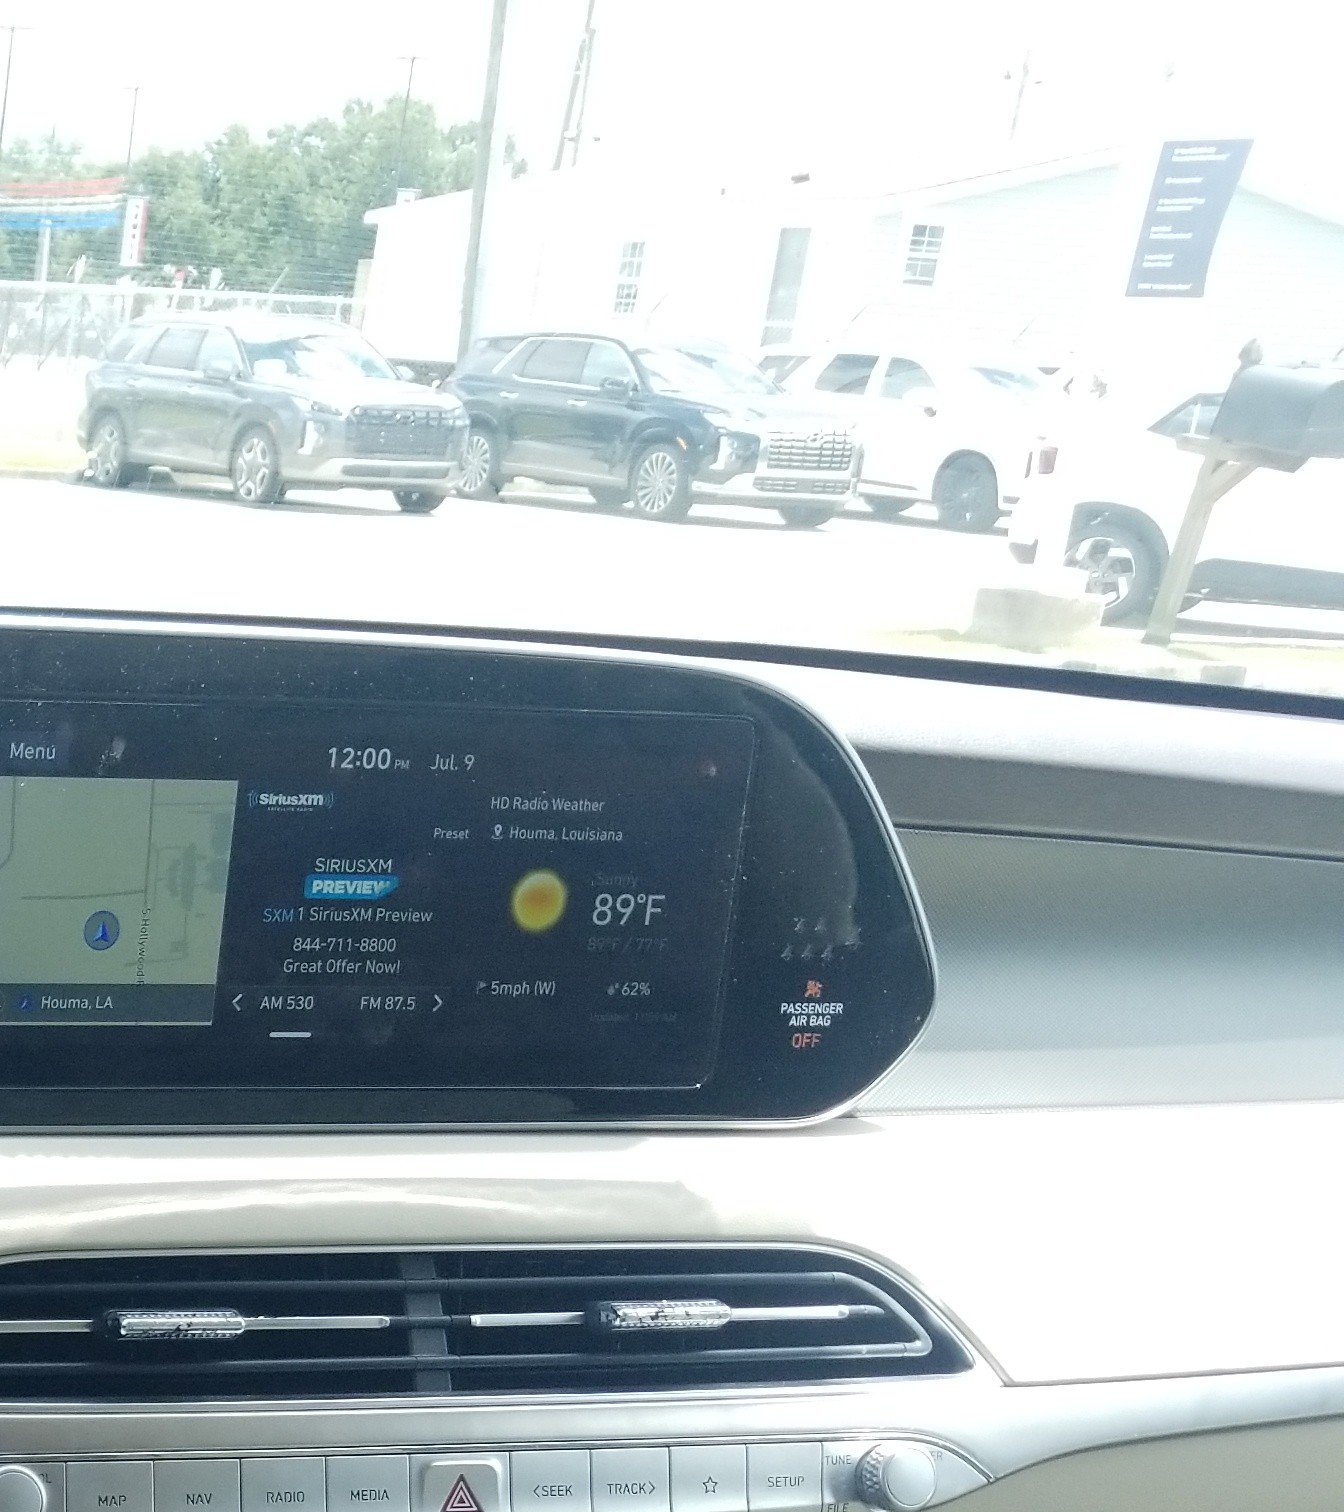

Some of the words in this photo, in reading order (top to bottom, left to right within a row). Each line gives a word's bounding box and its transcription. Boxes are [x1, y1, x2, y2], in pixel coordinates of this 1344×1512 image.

[9, 741, 56, 760] Menu
[328, 747, 391, 770] 12:00
[395, 758, 410, 769] PM
[429, 754, 458, 771] Jul.
[463, 754, 475, 770] 9
[490, 796, 510, 810] HD
[513, 796, 548, 810] Radio
[552, 797, 605, 812] Weather
[433, 827, 471, 840] Preset
[562, 827, 623, 841] Louisiana
[314, 857, 393, 873] SIRIUSXM
[312, 880, 392, 894] PREVIEW
[263, 908, 294, 923] SXM
[297, 906, 304, 921] 1
[309, 907, 372, 922] SiriusXM
[375, 908, 433, 922] Preview
[592, 893, 666, 926] 89°F
[136, 918, 150, 981] Hollywood
[293, 938, 397, 952] 844-711-8800
[283, 958, 322, 973] Great
[326, 959, 362, 973] Offer
[365, 960, 401, 974] Now!
[491, 981, 530, 997] 5mph
[534, 981, 556, 996] (W)
[621, 982, 651, 996] 62%
[41, 996, 92, 1010] Houma,
[95, 996, 114, 1009] LA
[260, 996, 283, 1010] AM
[286, 996, 314, 1010] 530
[360, 996, 381, 1010] FM
[384, 996, 416, 1010] 87.5
[781, 1003, 844, 1014] PASSENGER
[789, 1015, 808, 1026] AIR
[809, 1015, 832, 1026] BAG
[792, 1033, 822, 1048] OFF
[825, 1455, 852, 1465] TUNE
[767, 1476, 805, 1489] SETUP
[98, 1494, 127, 1507] MAP
[185, 1493, 212, 1506] NAV
[265, 1491, 306, 1503] RADIO
[349, 1489, 390, 1502] MEDIA
[827, 1503, 849, 1512] FILE
